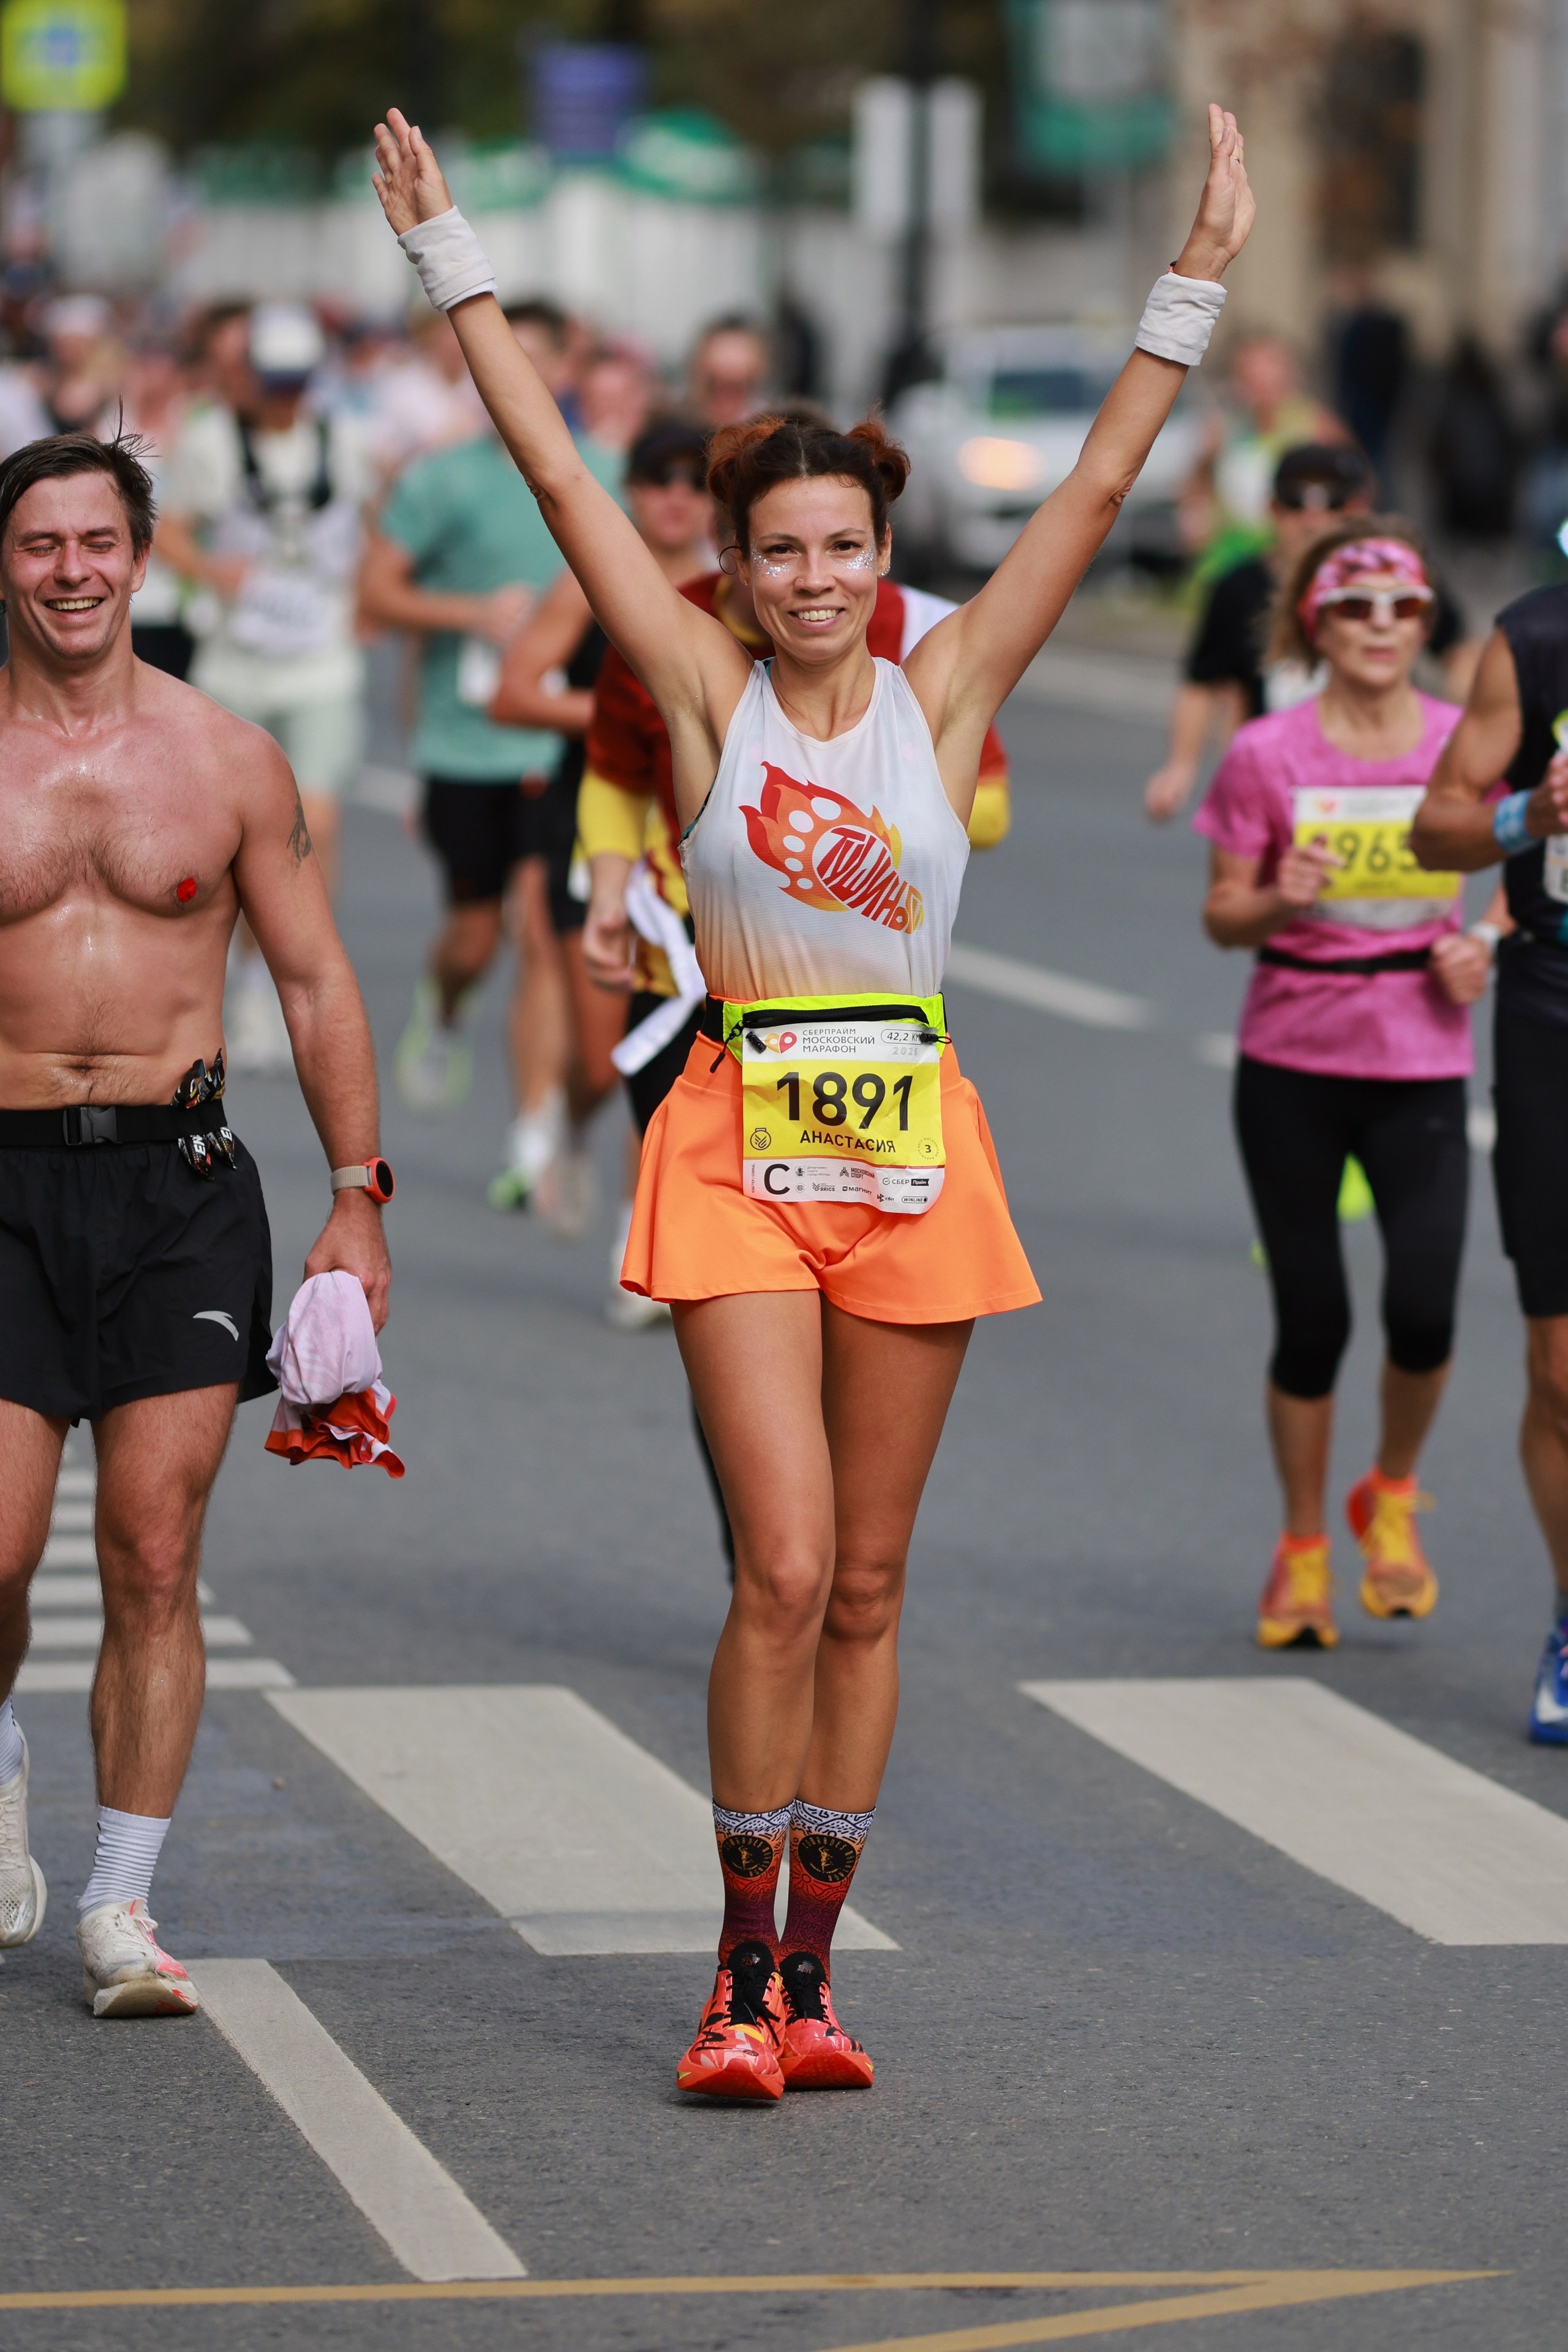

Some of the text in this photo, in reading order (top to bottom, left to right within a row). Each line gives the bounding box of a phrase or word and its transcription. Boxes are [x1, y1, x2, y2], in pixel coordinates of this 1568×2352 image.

[802, 1027, 856, 1036] СБЕРПРАЙМ
[802, 1035, 875, 1044] МОСКОВСКИЙ
[887, 1032, 909, 1042] 42,2
[777, 1071, 913, 1131] 1891
[799, 1129, 896, 1153] АНАСТАСИЯ
[925, 1144, 932, 1153] 3
